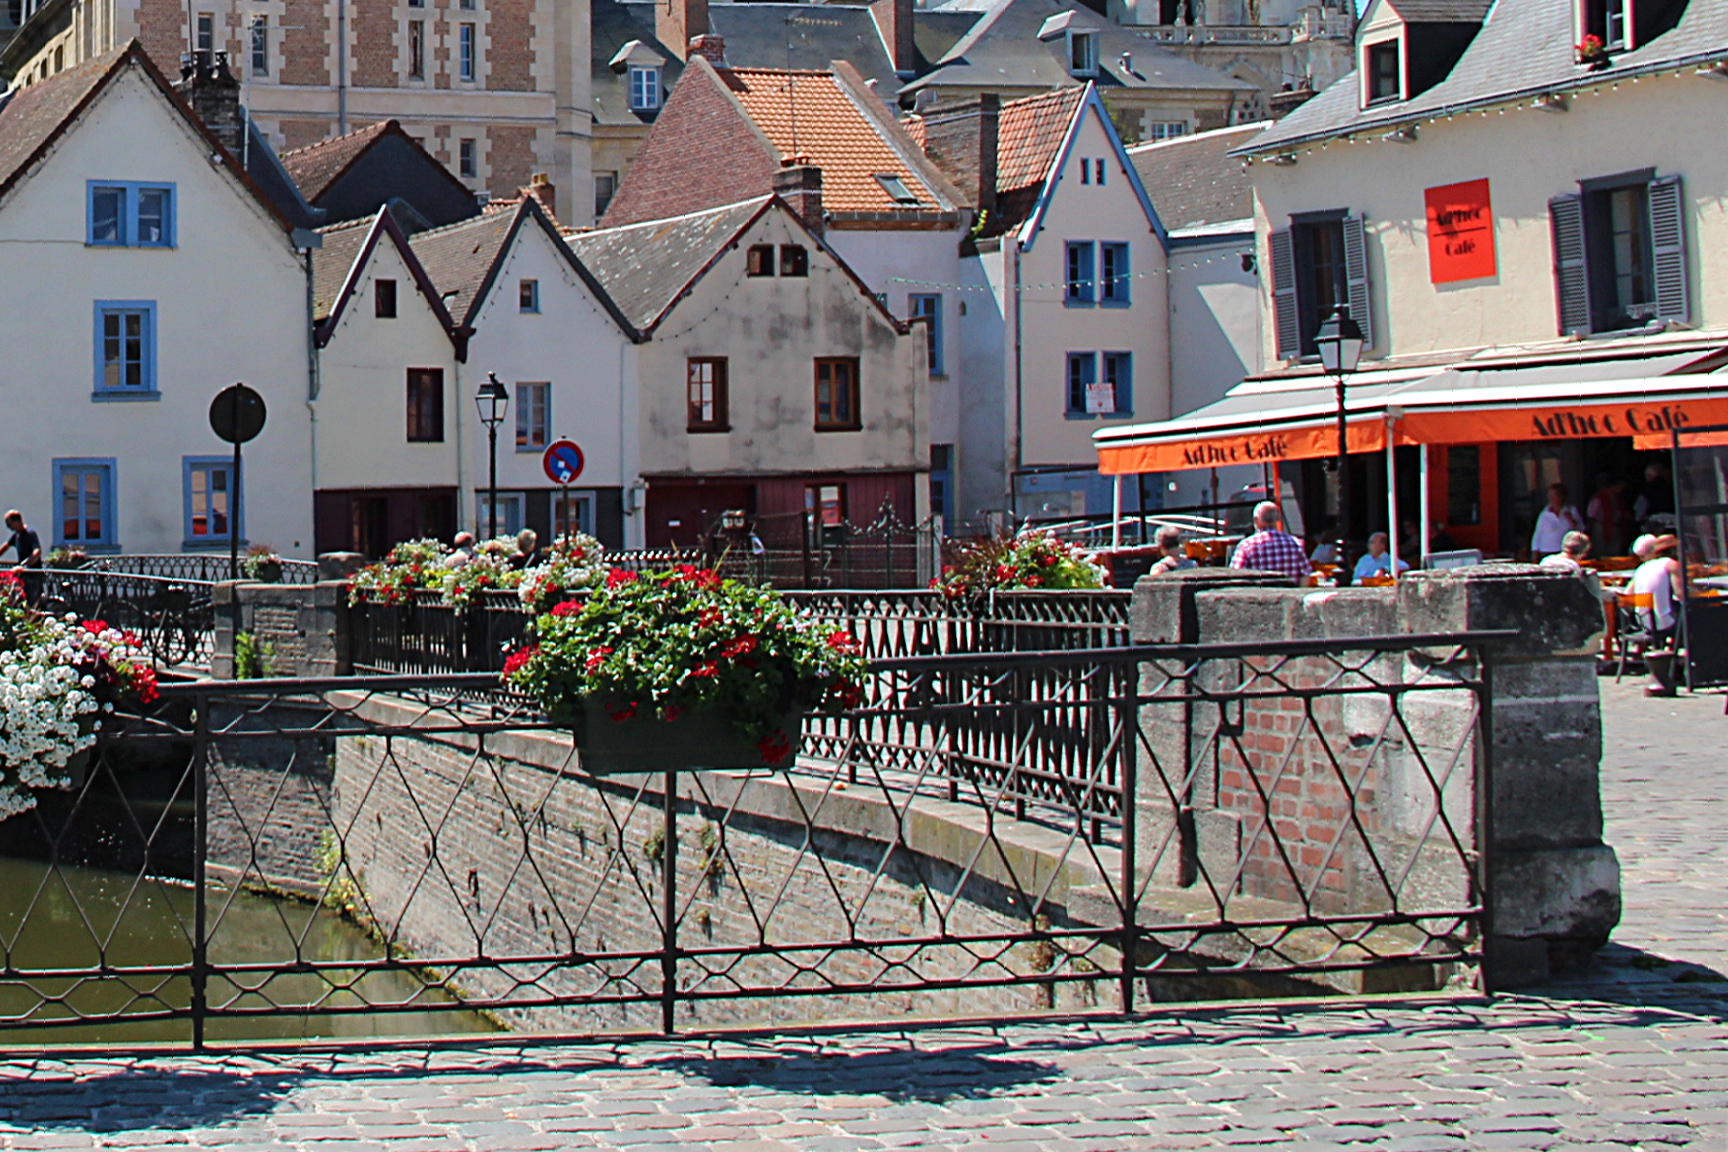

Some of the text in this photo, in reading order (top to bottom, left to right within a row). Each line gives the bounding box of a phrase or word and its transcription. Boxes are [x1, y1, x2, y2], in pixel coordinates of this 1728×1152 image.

[1445, 237, 1476, 256] Café
[1531, 404, 1689, 437] Ad'hoc Café
